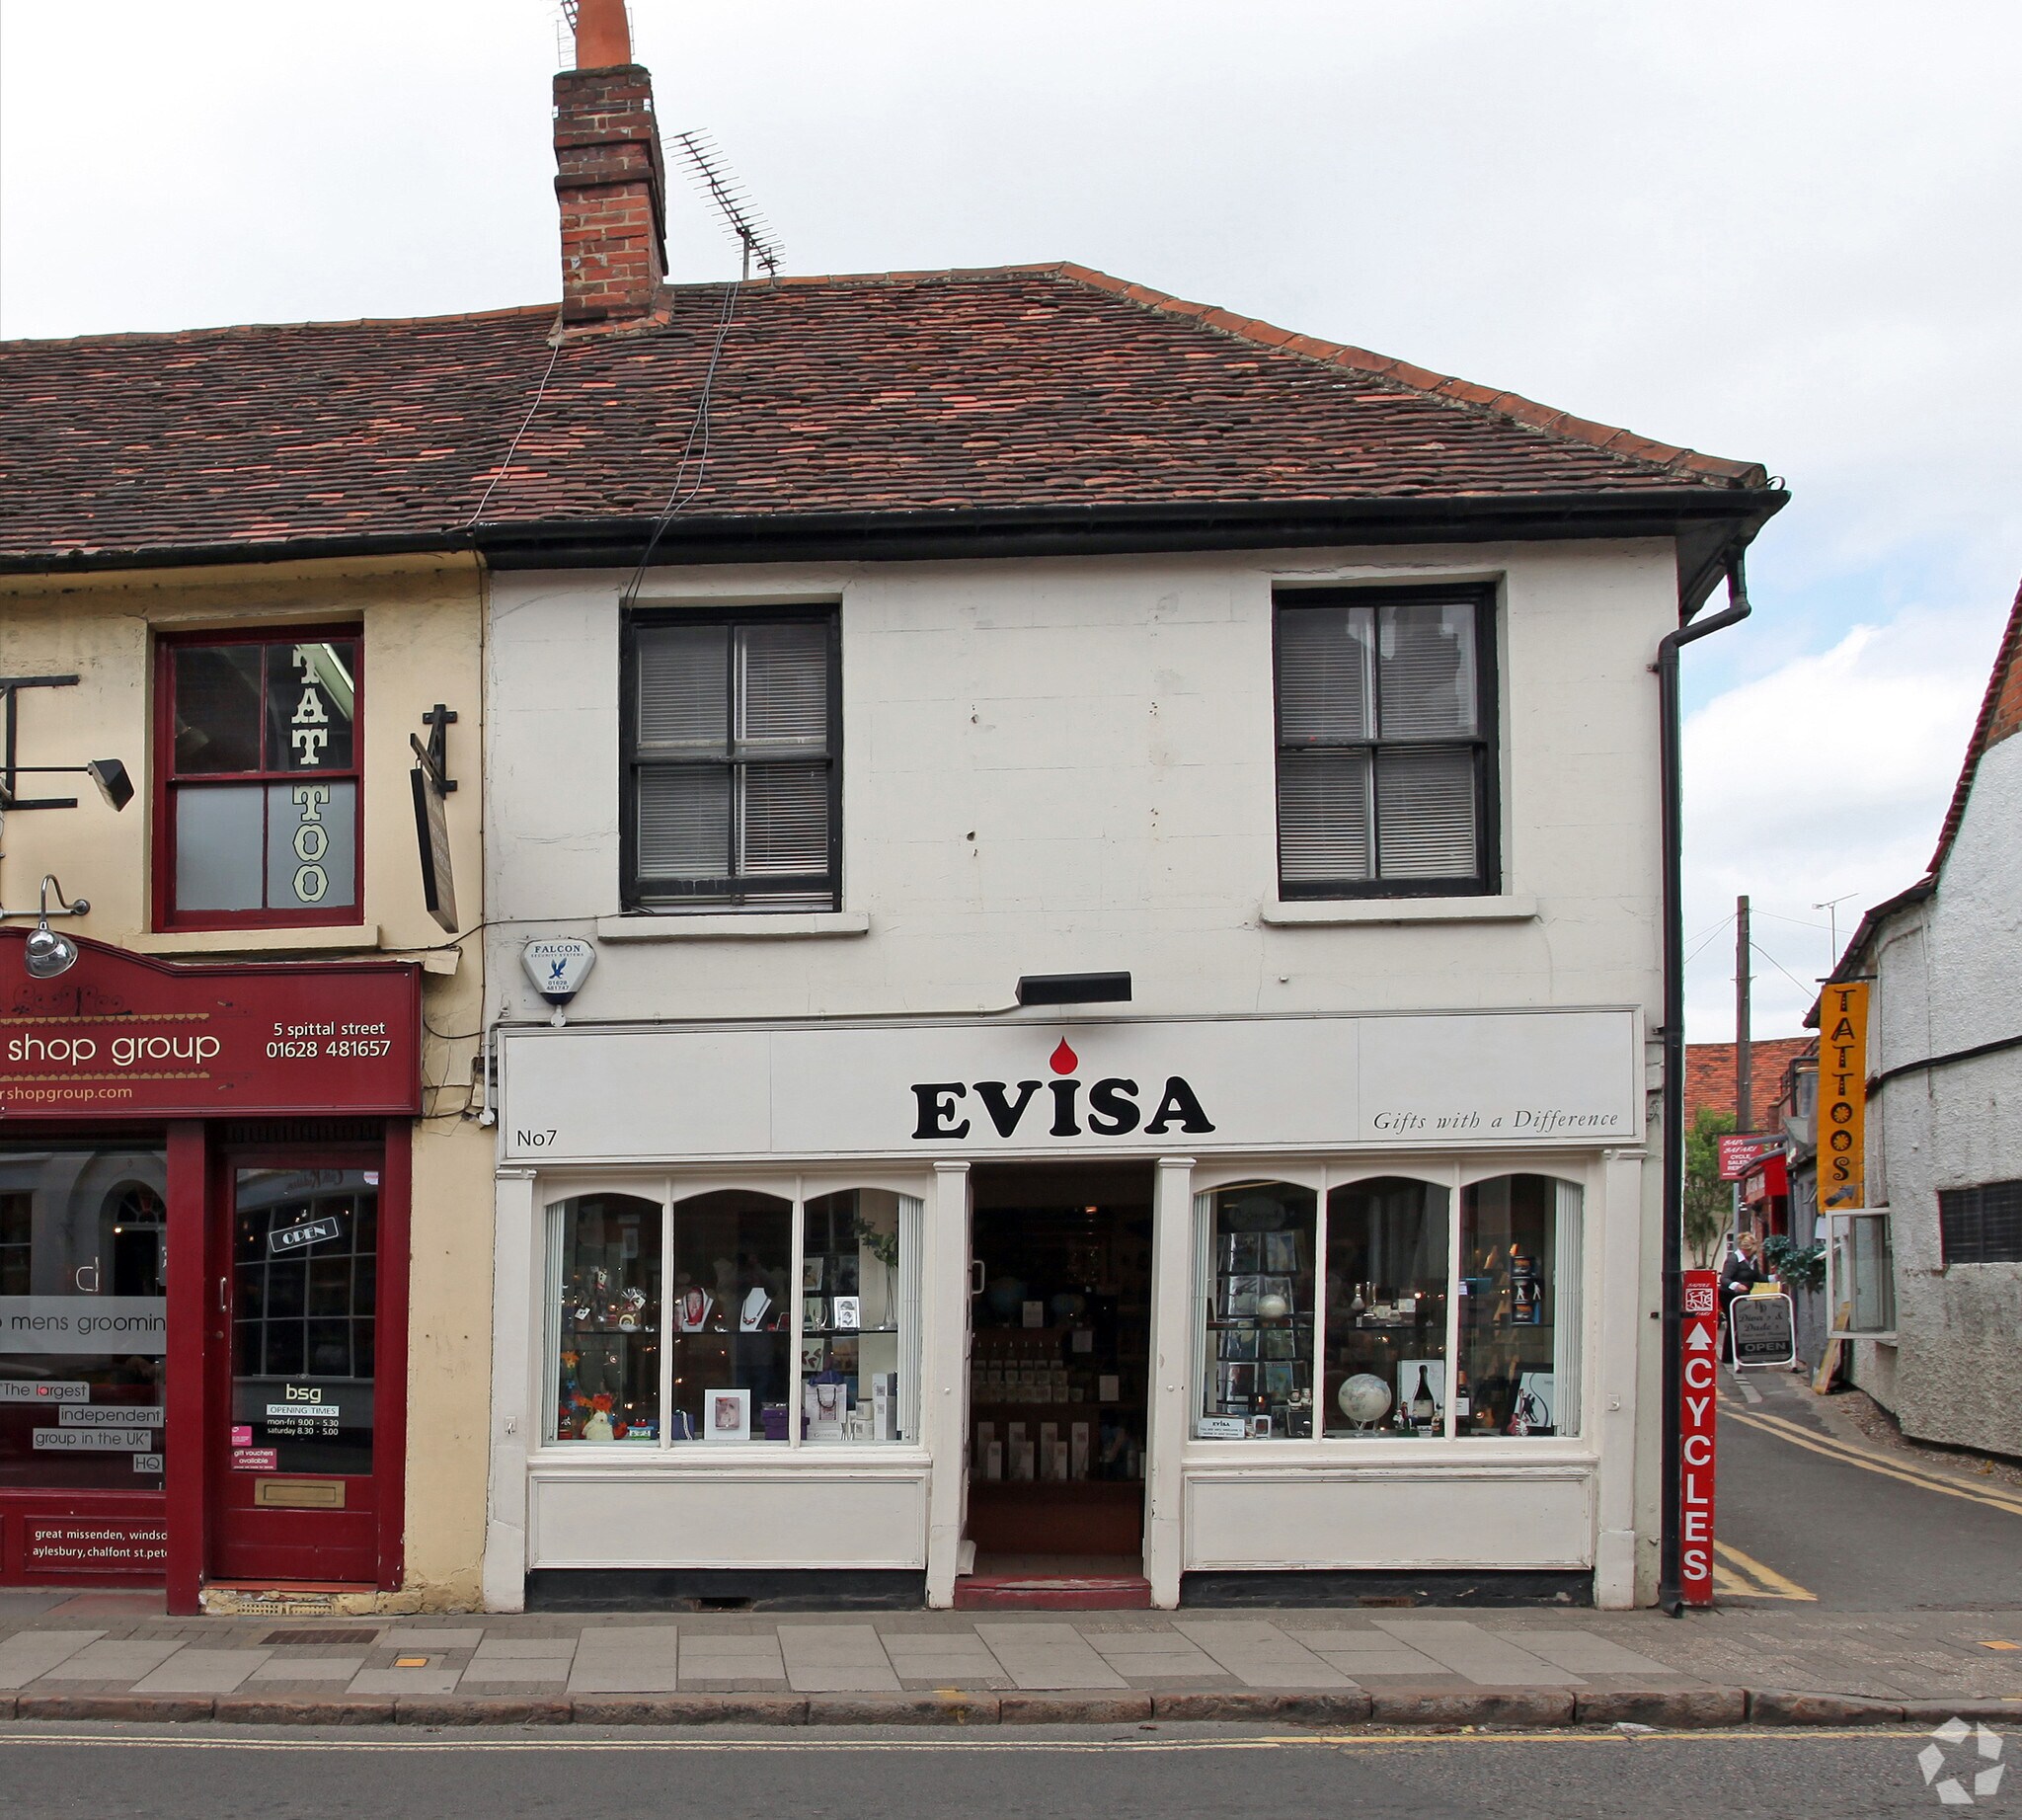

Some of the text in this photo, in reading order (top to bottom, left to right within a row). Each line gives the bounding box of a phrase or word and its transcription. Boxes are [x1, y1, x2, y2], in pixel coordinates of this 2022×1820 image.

[291, 646, 330, 903] TATTOO
[273, 1021, 385, 1039] 5 spittal street
[8, 1033, 221, 1067] shop group
[266, 1040, 391, 1058] 01628 481657
[1830, 989, 1856, 1181] TATTOOS
[0, 1086, 132, 1103] rshopgroup.com
[1373, 1110, 1619, 1135] Gifts with a Difference
[517, 1130, 558, 1147] No7
[282, 1226, 327, 1244] OPEN
[12, 1315, 68, 1331] mens
[1745, 1342, 1786, 1352] OPEN
[36, 1384, 87, 1399] largest
[285, 1384, 322, 1404] bsg
[61, 1408, 161, 1423] independent
[270, 1406, 308, 1415] OPENING
[35, 1433, 76, 1446] group
[82, 1432, 93, 1444] in
[99, 1433, 121, 1445] the
[267, 1427, 296, 1436] saturday
[135, 1457, 160, 1469] HQ
[1683, 1358, 1712, 1580] CYCLES
[35, 1530, 62, 1541] great
[66, 1529, 125, 1541] missenden,
[33, 1546, 86, 1558] aylesbury,
[87, 1546, 130, 1557] chalfont
